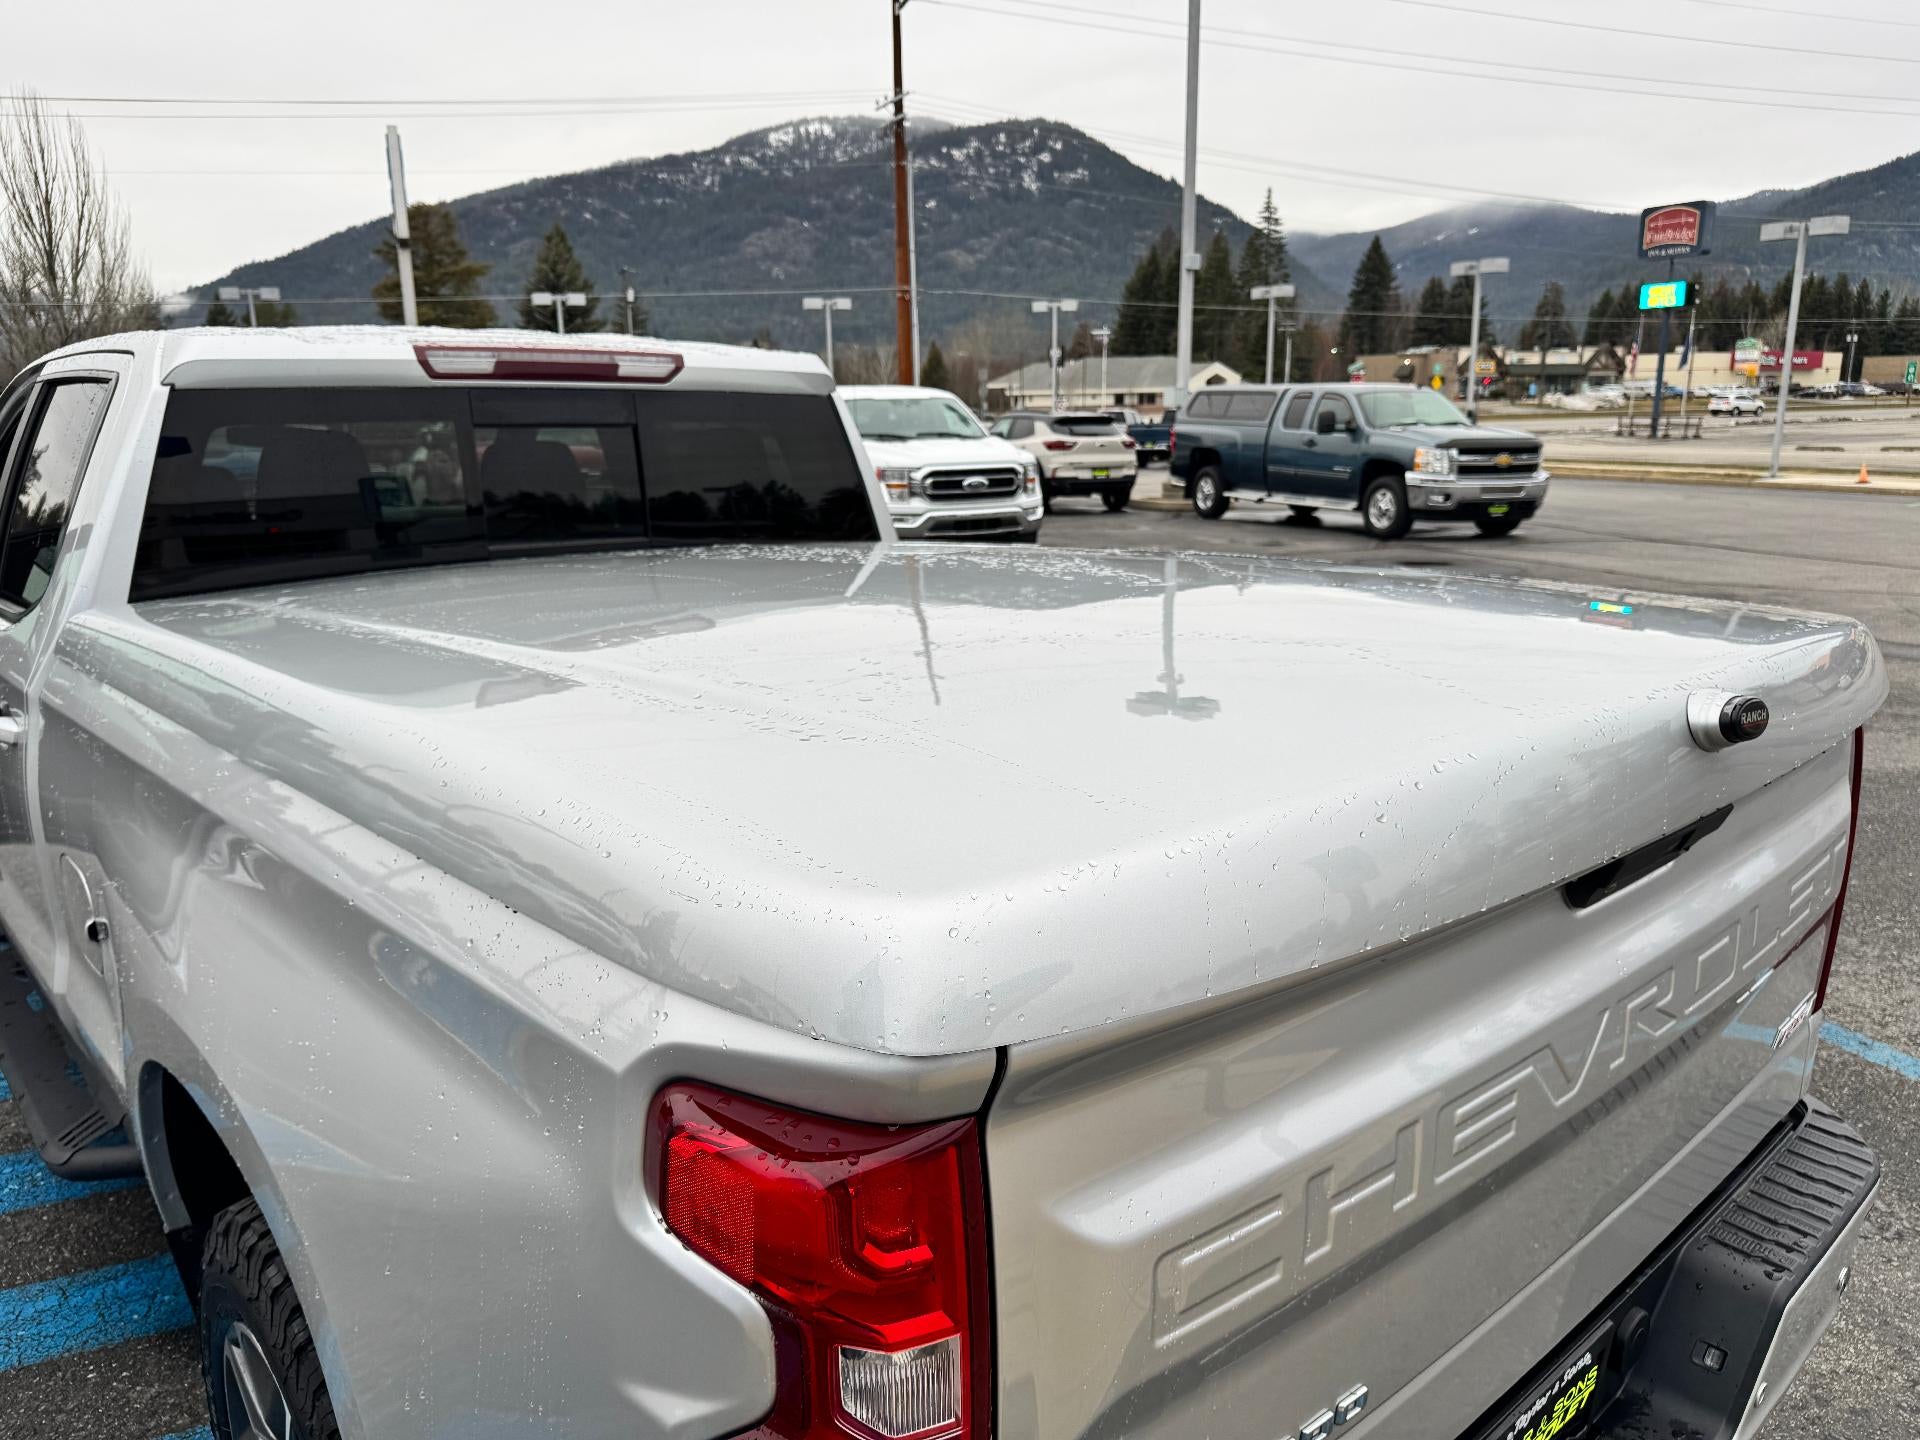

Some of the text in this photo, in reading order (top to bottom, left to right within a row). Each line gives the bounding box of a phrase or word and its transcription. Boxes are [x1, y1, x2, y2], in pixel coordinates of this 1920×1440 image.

[1741, 708, 1767, 724] RANCH
[1152, 836, 1846, 1348] CHEVROLET
[1514, 1390, 1551, 1435] Taylor
[1535, 1383, 1596, 1440] OLET
[1552, 1365, 1598, 1418] SONS
